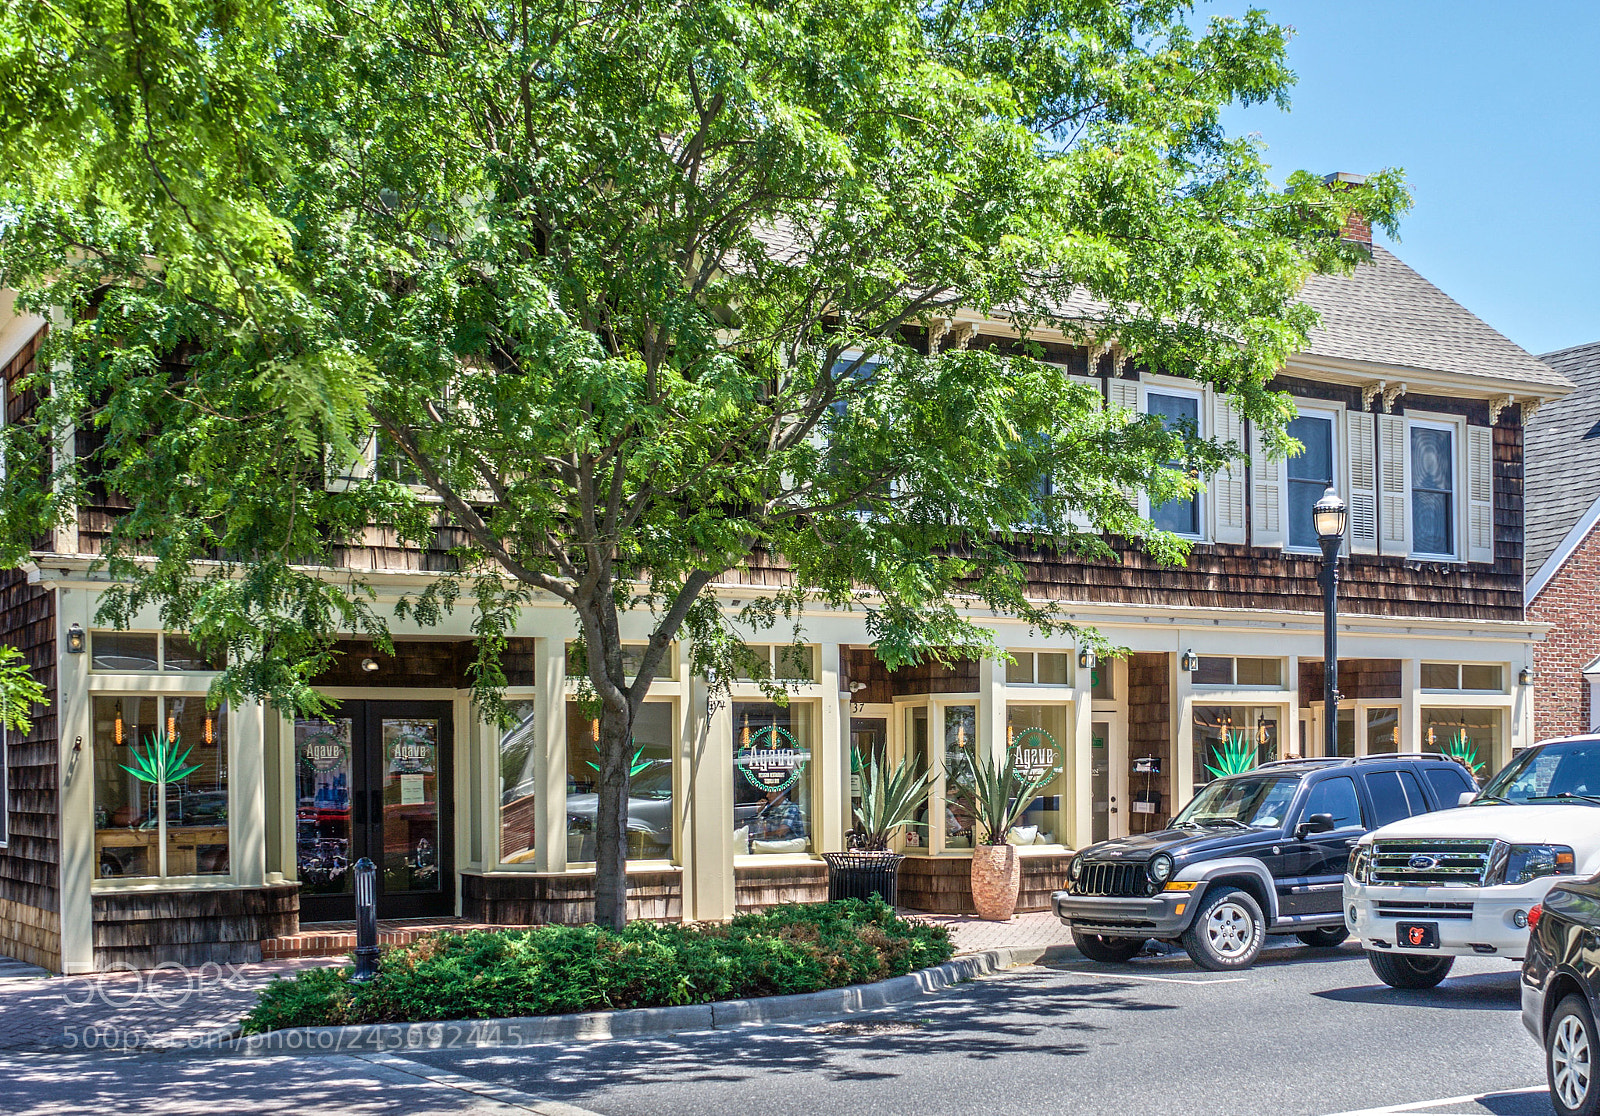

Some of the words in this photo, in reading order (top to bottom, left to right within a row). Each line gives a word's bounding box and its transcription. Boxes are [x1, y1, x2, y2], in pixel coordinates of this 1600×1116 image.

[853, 702, 865, 713] 37
[306, 743, 340, 760] Agave
[394, 743, 427, 759] Agave
[748, 745, 795, 771] Agave
[1014, 745, 1054, 769] Agave
